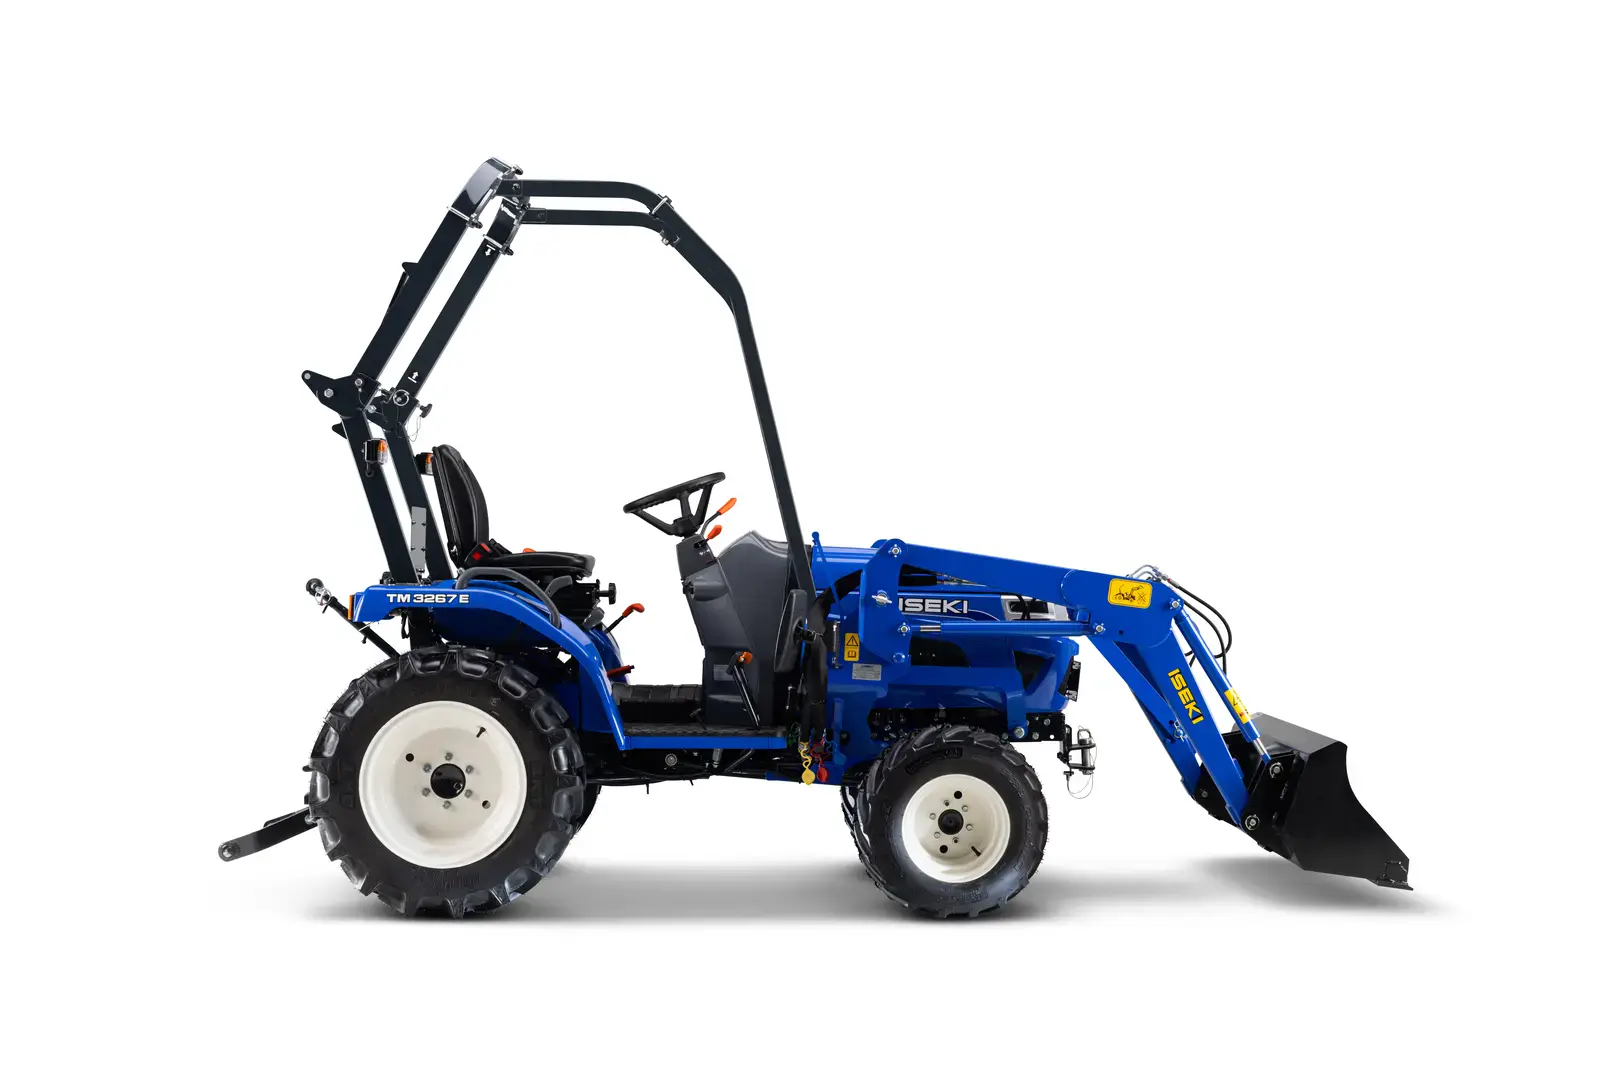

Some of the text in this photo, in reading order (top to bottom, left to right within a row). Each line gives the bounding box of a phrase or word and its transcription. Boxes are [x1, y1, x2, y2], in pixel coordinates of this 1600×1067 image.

[386, 593, 411, 603] TM
[898, 597, 968, 614] ISEKI
[1167, 668, 1205, 725] ISEKI
